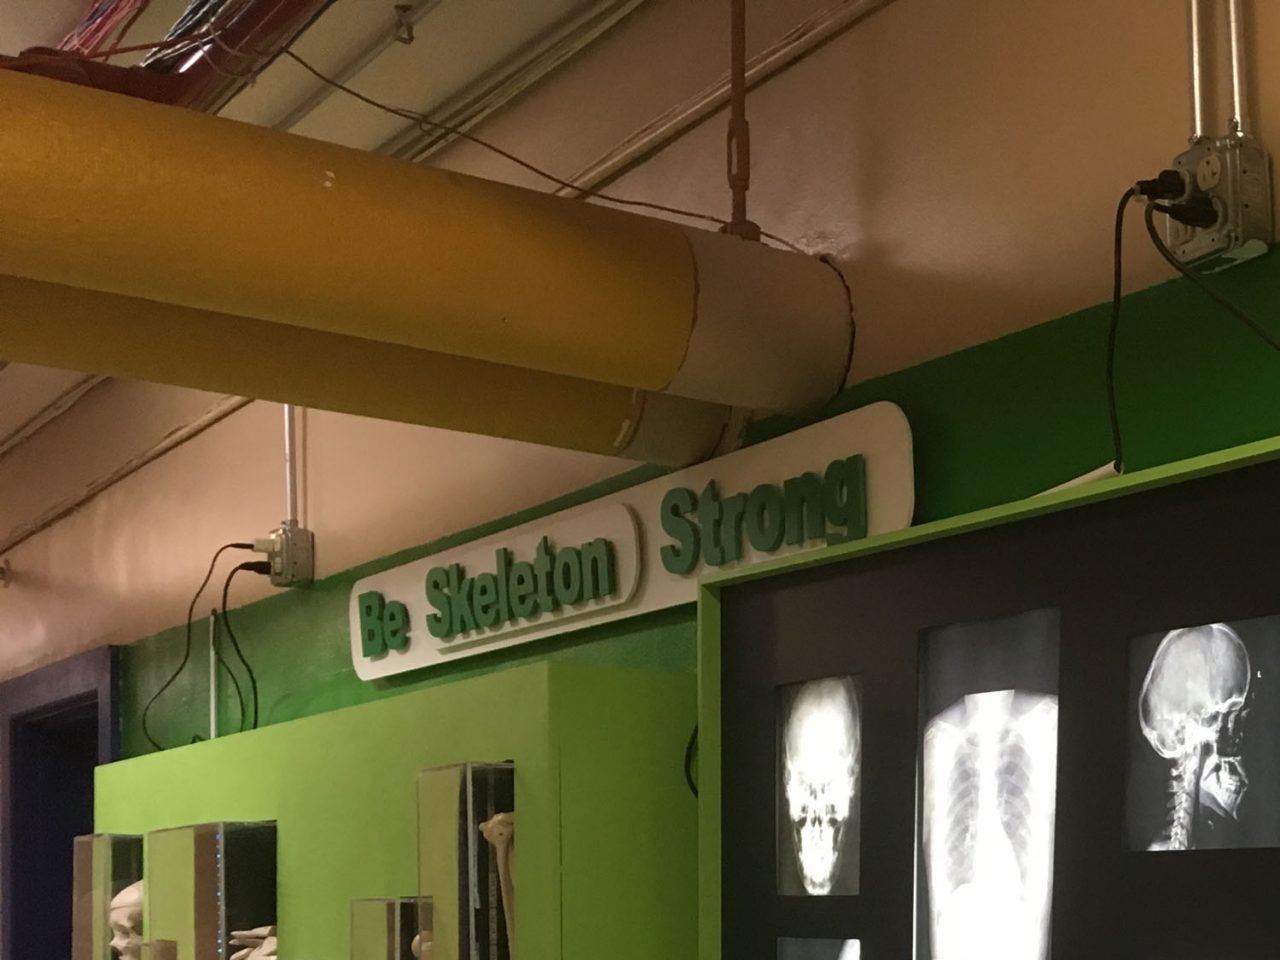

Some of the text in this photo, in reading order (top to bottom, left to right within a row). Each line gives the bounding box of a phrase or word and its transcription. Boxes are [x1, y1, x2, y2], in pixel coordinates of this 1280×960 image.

[358, 453, 868, 658] Be Skeleton Strong
